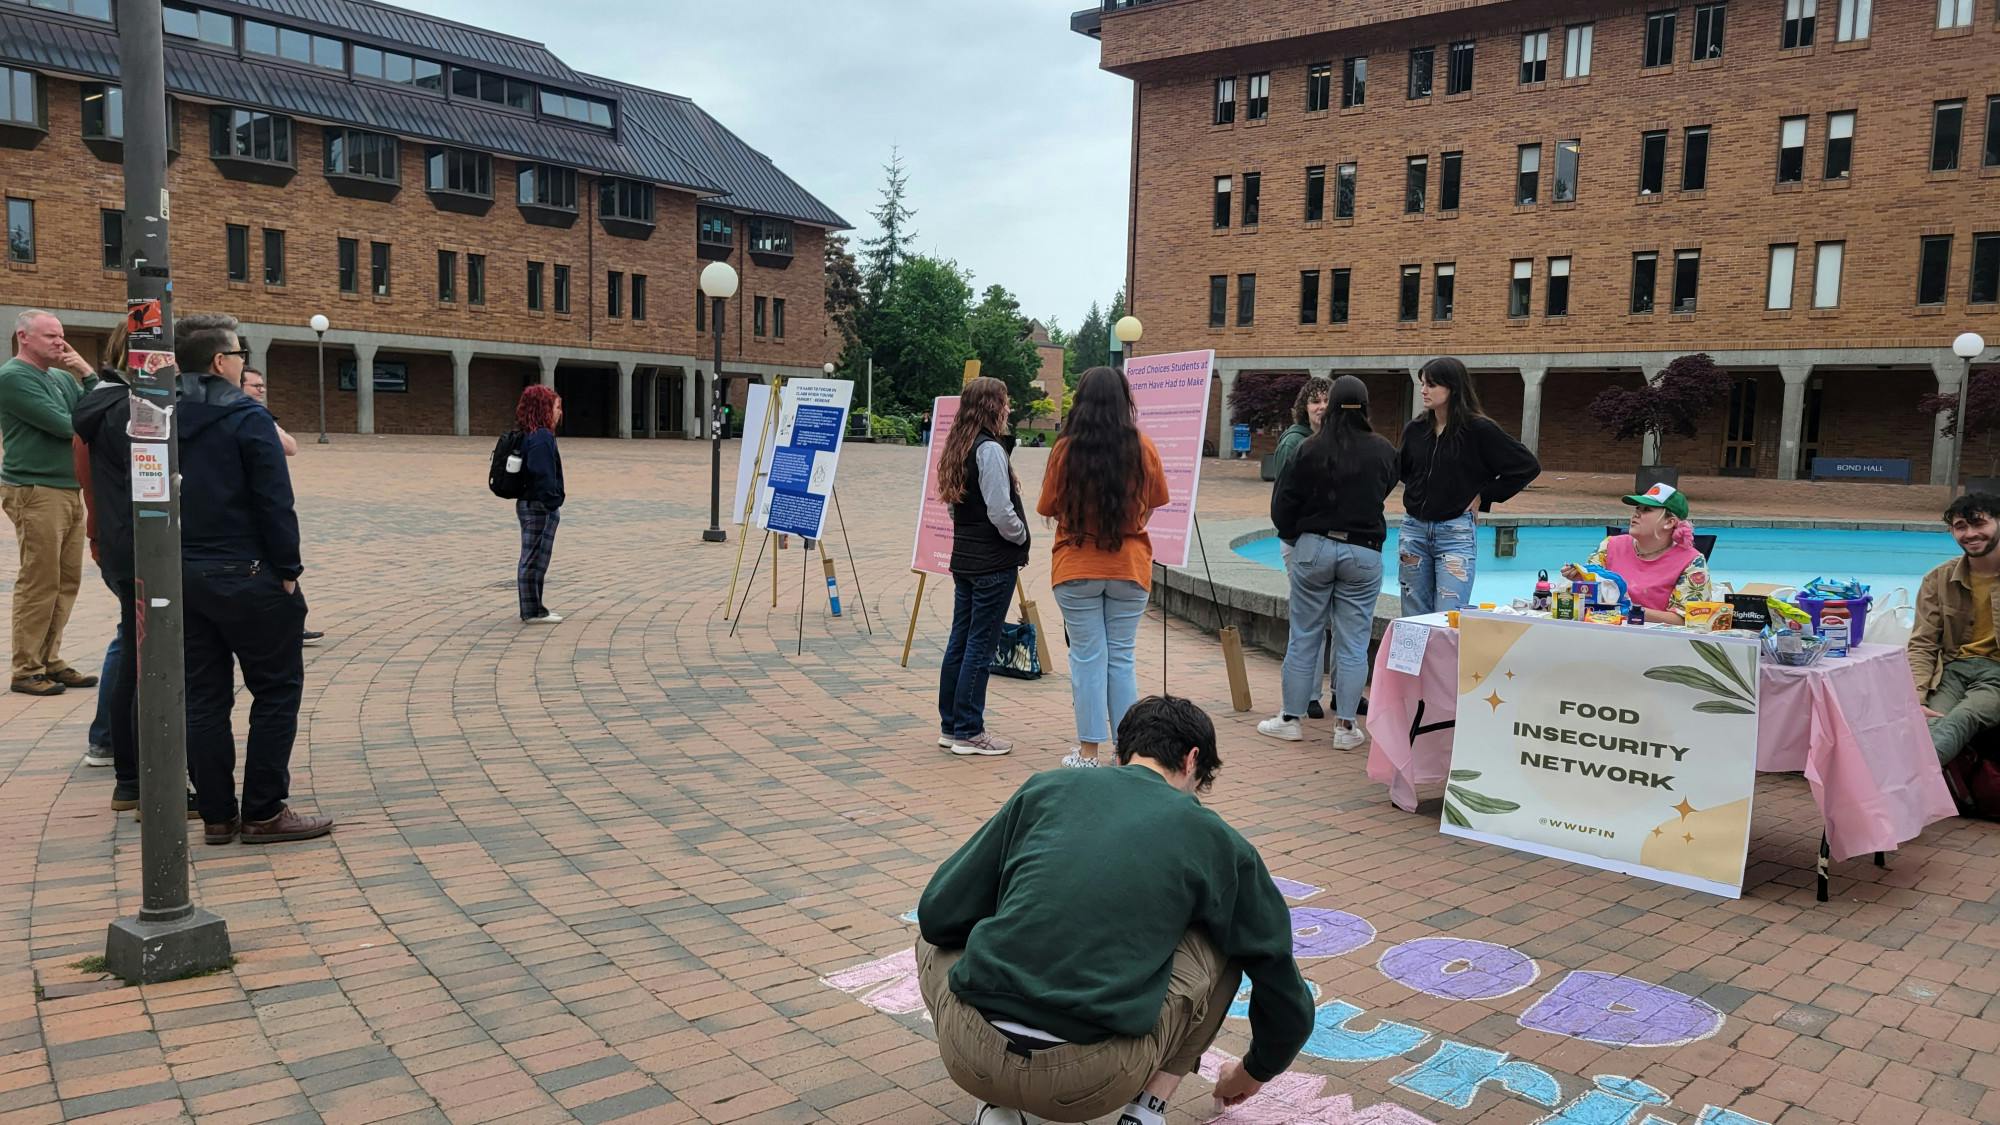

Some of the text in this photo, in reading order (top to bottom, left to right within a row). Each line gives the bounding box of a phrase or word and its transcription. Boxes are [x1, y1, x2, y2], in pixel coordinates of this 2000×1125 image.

[1127, 361, 1208, 376] Forced Choices Students at
[1129, 378, 1204, 391] estern Have Had to Make
[1836, 464, 1883, 472] BOND HALL
[1732, 610, 1765, 620] RightRice
[1559, 700, 1640, 725] FOOD
[1513, 721, 1691, 762] INSECURITY
[1520, 751, 1676, 792] NETWORK
[1538, 817, 1615, 839] @WWUFIN
